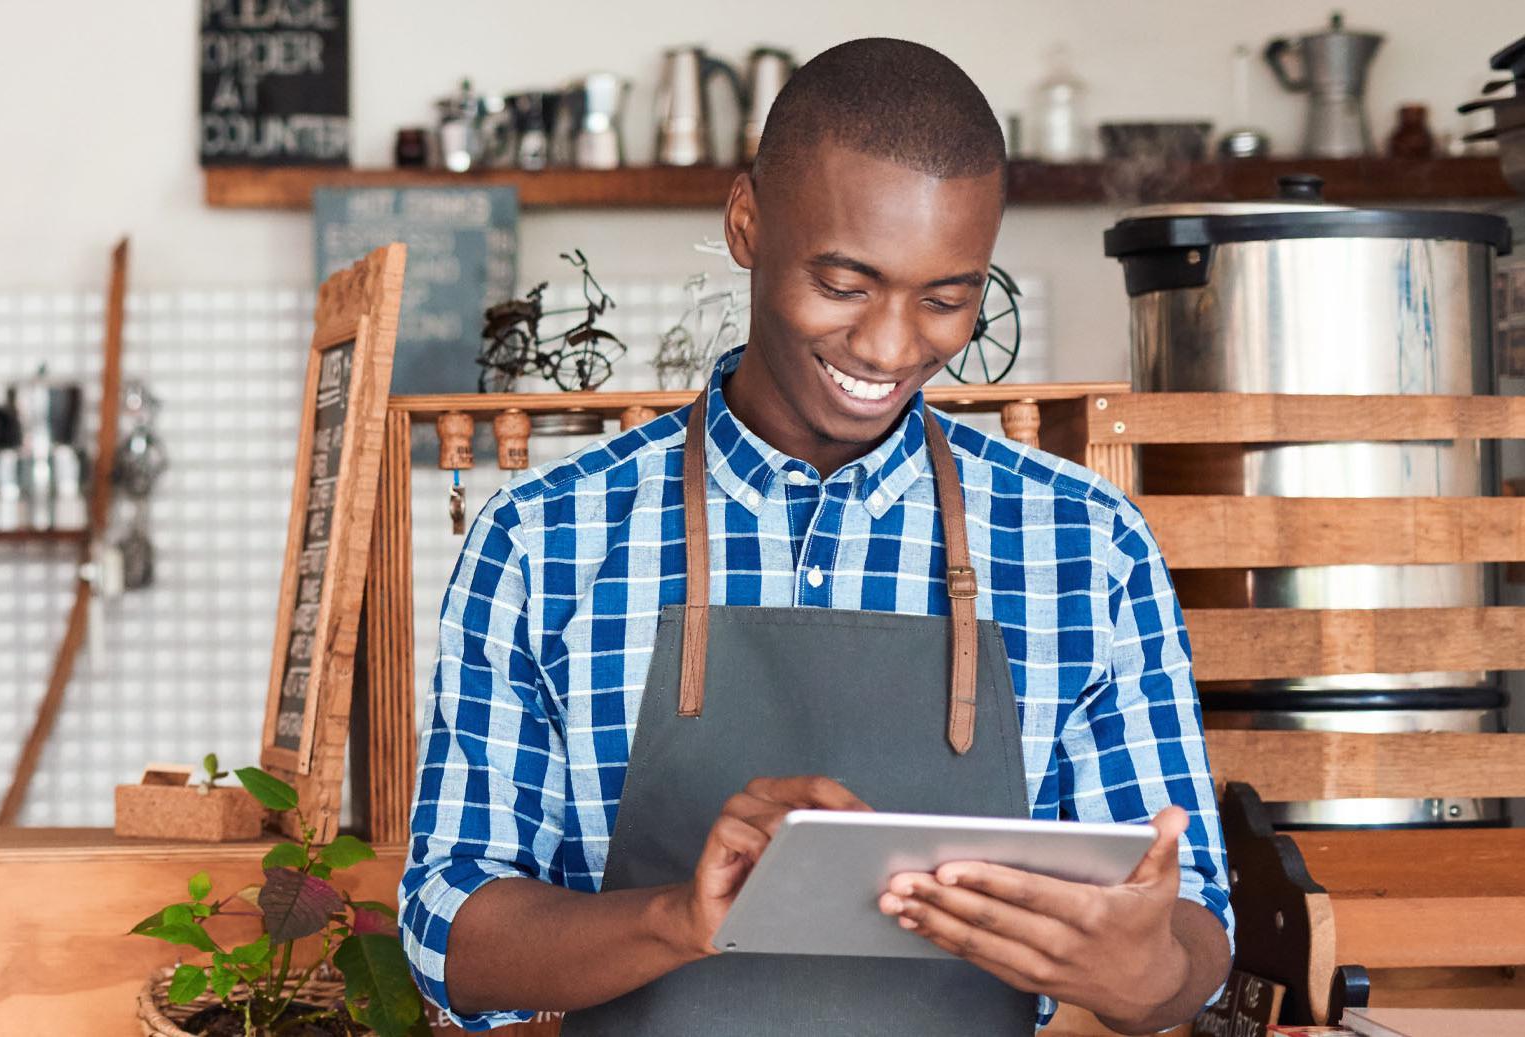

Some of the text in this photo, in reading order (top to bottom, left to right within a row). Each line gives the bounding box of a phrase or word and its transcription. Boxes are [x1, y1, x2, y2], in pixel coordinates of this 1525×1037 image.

[202, 31, 324, 75] ORDER
[211, 70, 258, 110] AT
[202, 113, 350, 158] COUNTER
